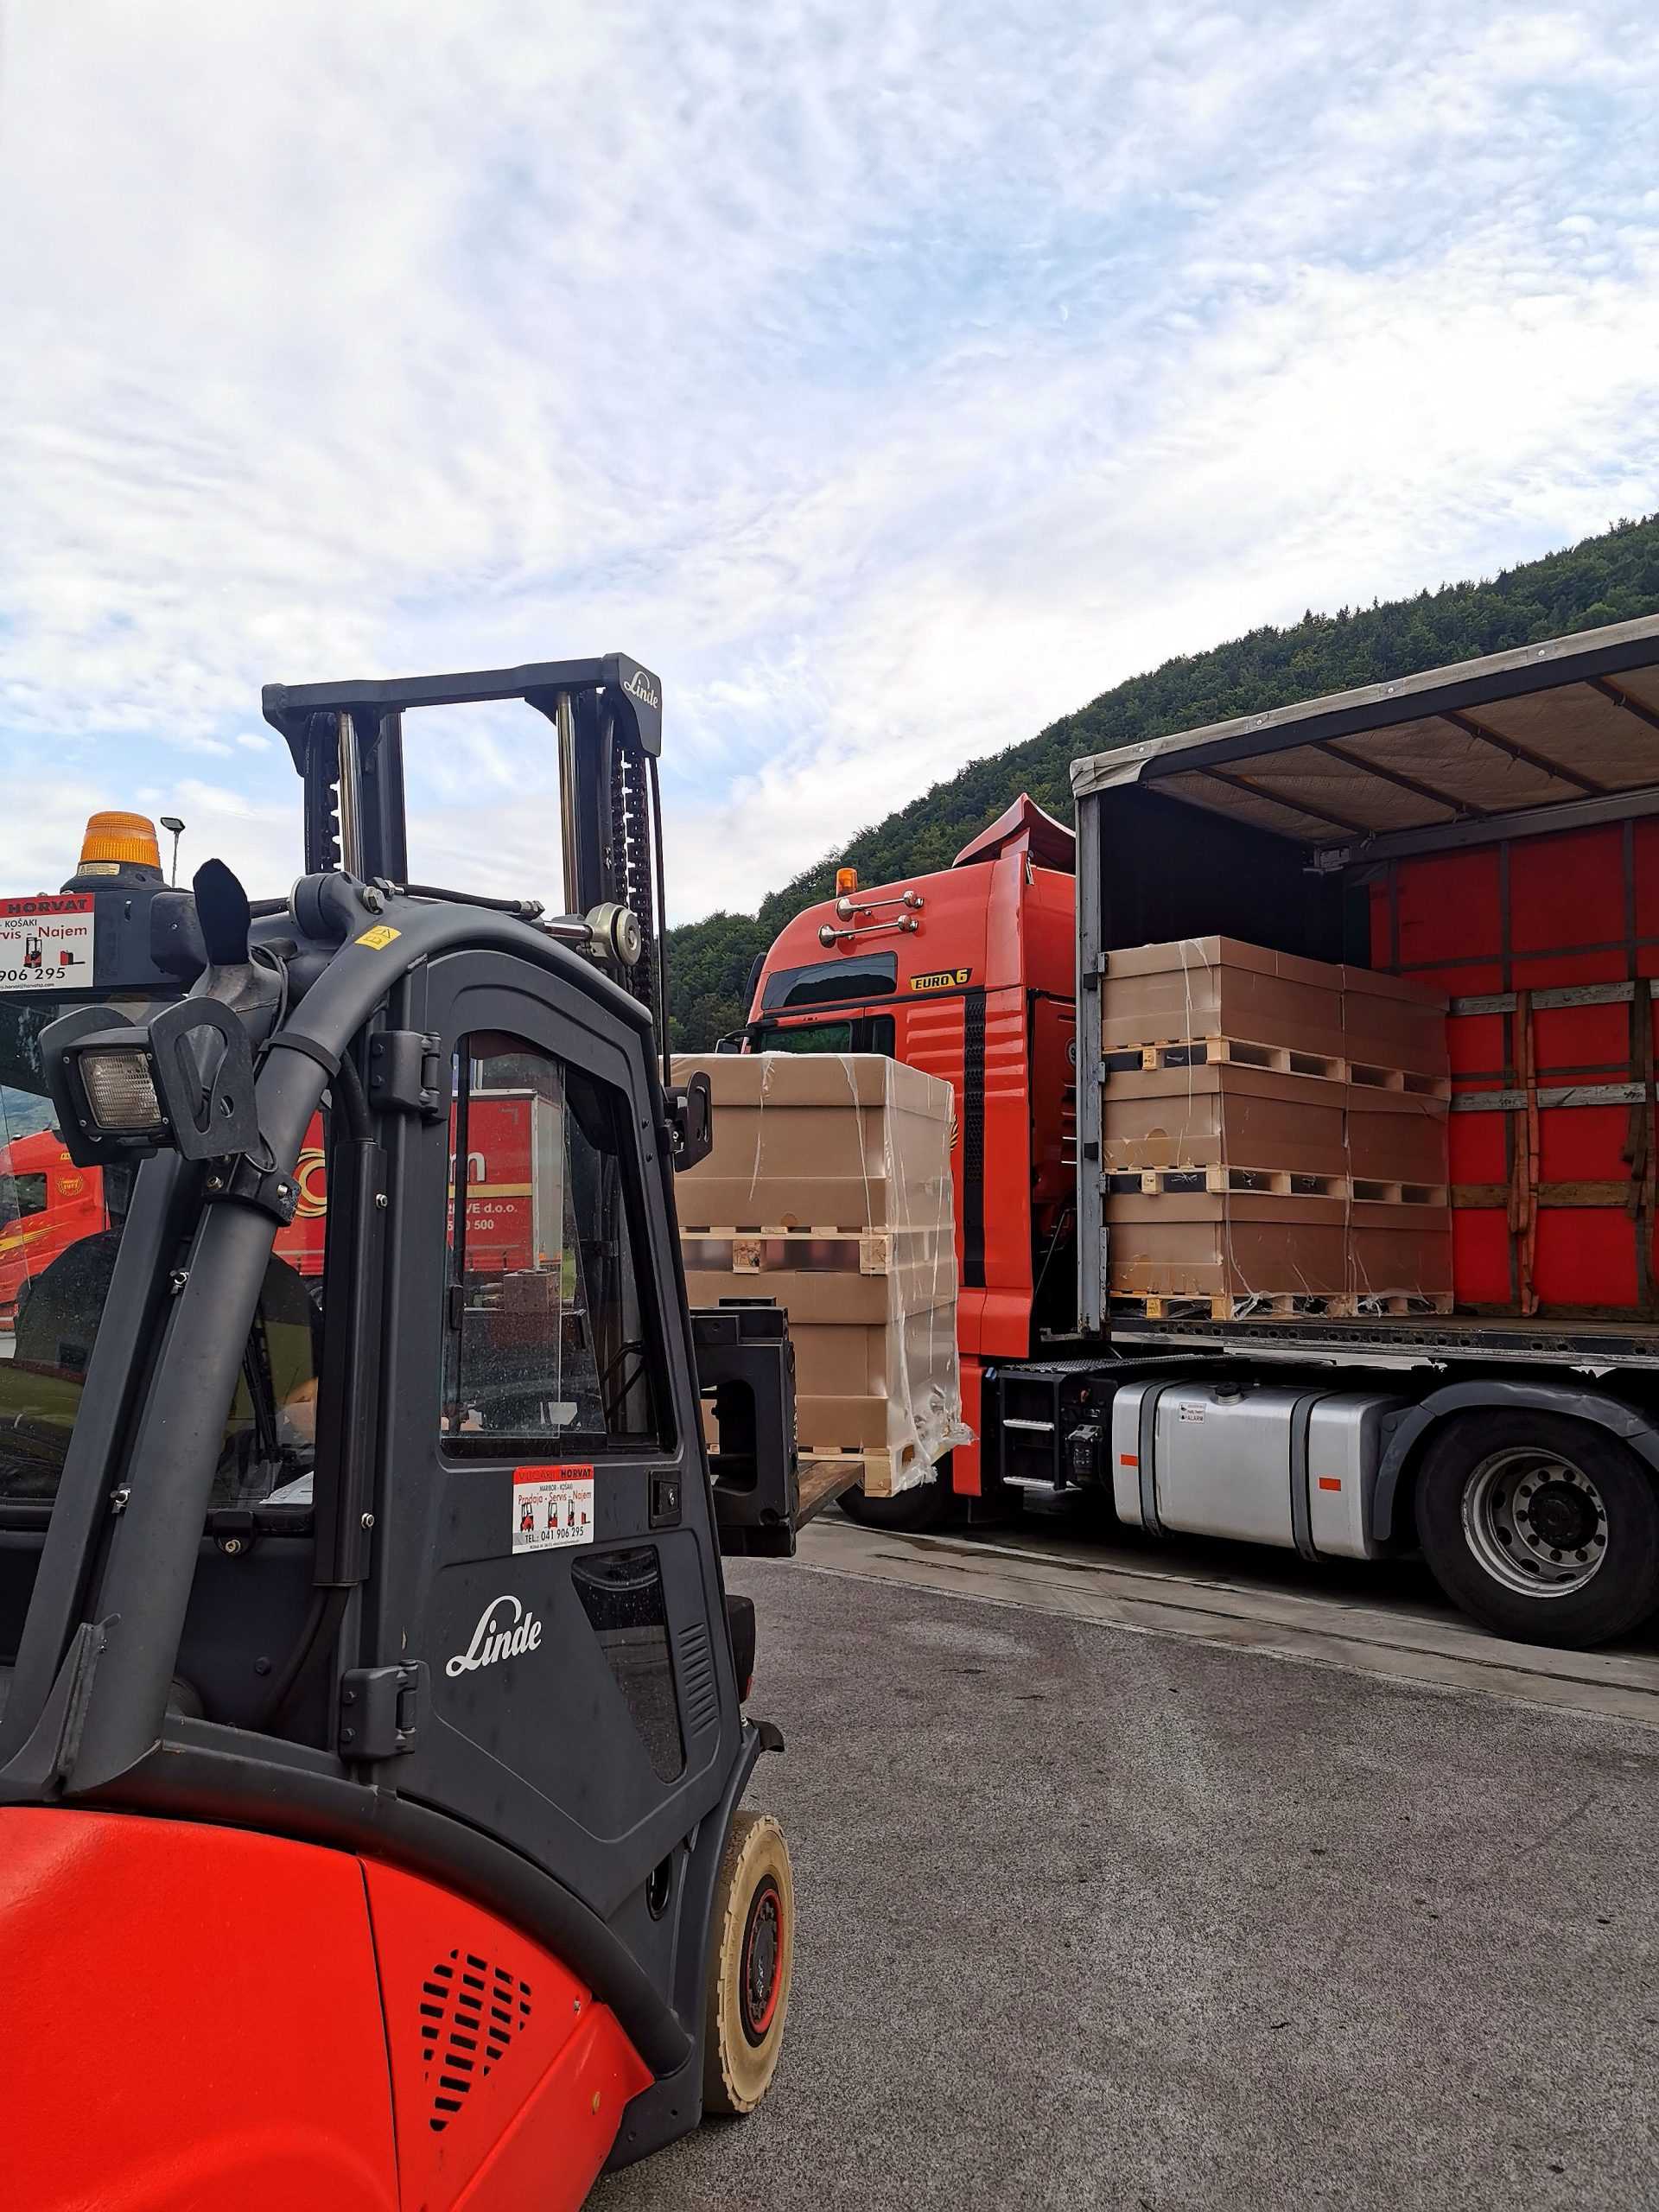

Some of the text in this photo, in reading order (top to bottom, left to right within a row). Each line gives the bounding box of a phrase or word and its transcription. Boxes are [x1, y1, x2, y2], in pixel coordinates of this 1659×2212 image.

[624, 671, 658, 709] Linde
[8, 899, 87, 913] HORVAT
[5, 918, 37, 928] KOŠAKI
[38, 925, 87, 939] Najem
[0, 968, 66, 982] 906 295
[916, 969, 968, 988] EURO 6
[484, 1202, 518, 1213] d.o.o.
[474, 1219, 494, 1230] 500
[561, 1469, 591, 1478] HORVAT
[518, 1492, 543, 1505] Prodaja
[549, 1491, 567, 1503] Servis
[572, 1489, 591, 1501] Najem
[541, 1529, 554, 1541] 041
[556, 1529, 569, 1539] 906
[572, 1526, 584, 1537] 295
[446, 1595, 542, 1676] Linde
